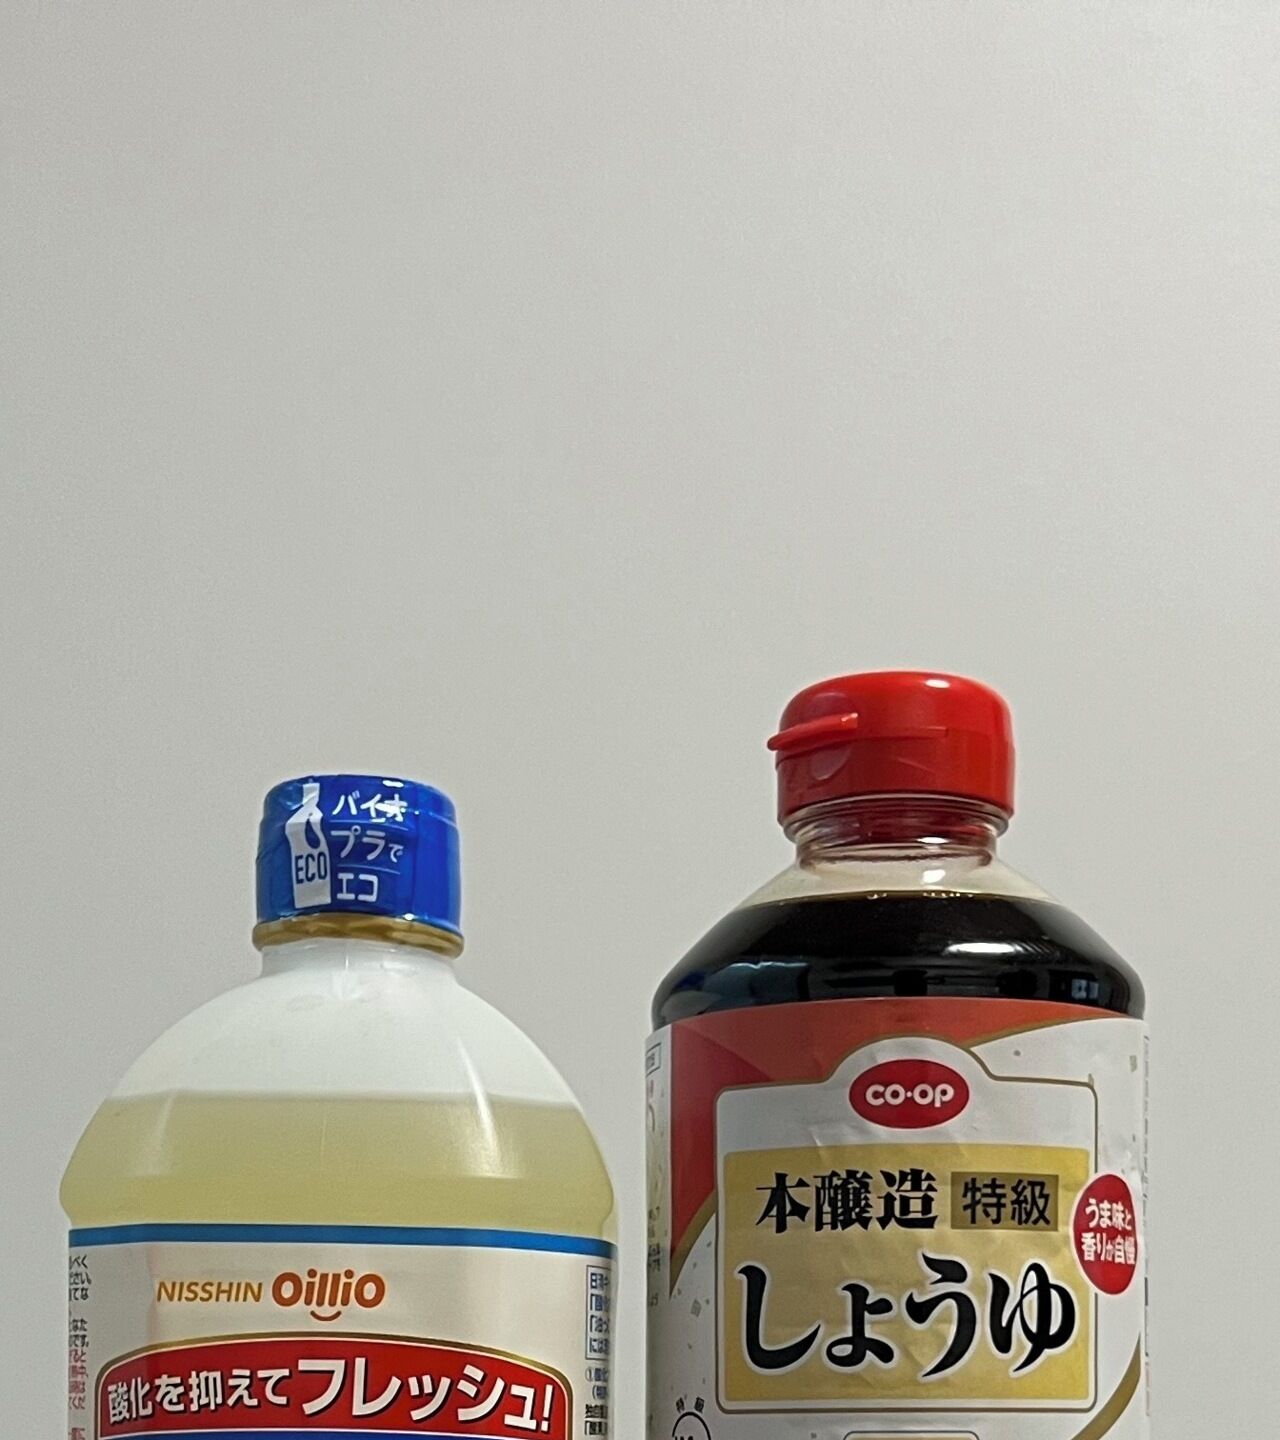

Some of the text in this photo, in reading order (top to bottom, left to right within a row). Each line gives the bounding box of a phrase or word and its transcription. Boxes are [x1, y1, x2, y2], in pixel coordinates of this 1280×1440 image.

[332, 790, 408, 823] バイオ
[330, 825, 404, 863] プラで
[294, 851, 328, 885] ECO
[336, 872, 379, 902] エコ
[755, 1168, 938, 1234] 本醸造
[961, 1177, 1052, 1227] 特級
[1085, 1197, 1133, 1231] うま味と
[155, 1279, 263, 1305] NISSHIN
[736, 1252, 1077, 1379] しょうゆ
[107, 1357, 555, 1433] 酸化を抑えてフレッシュ!
